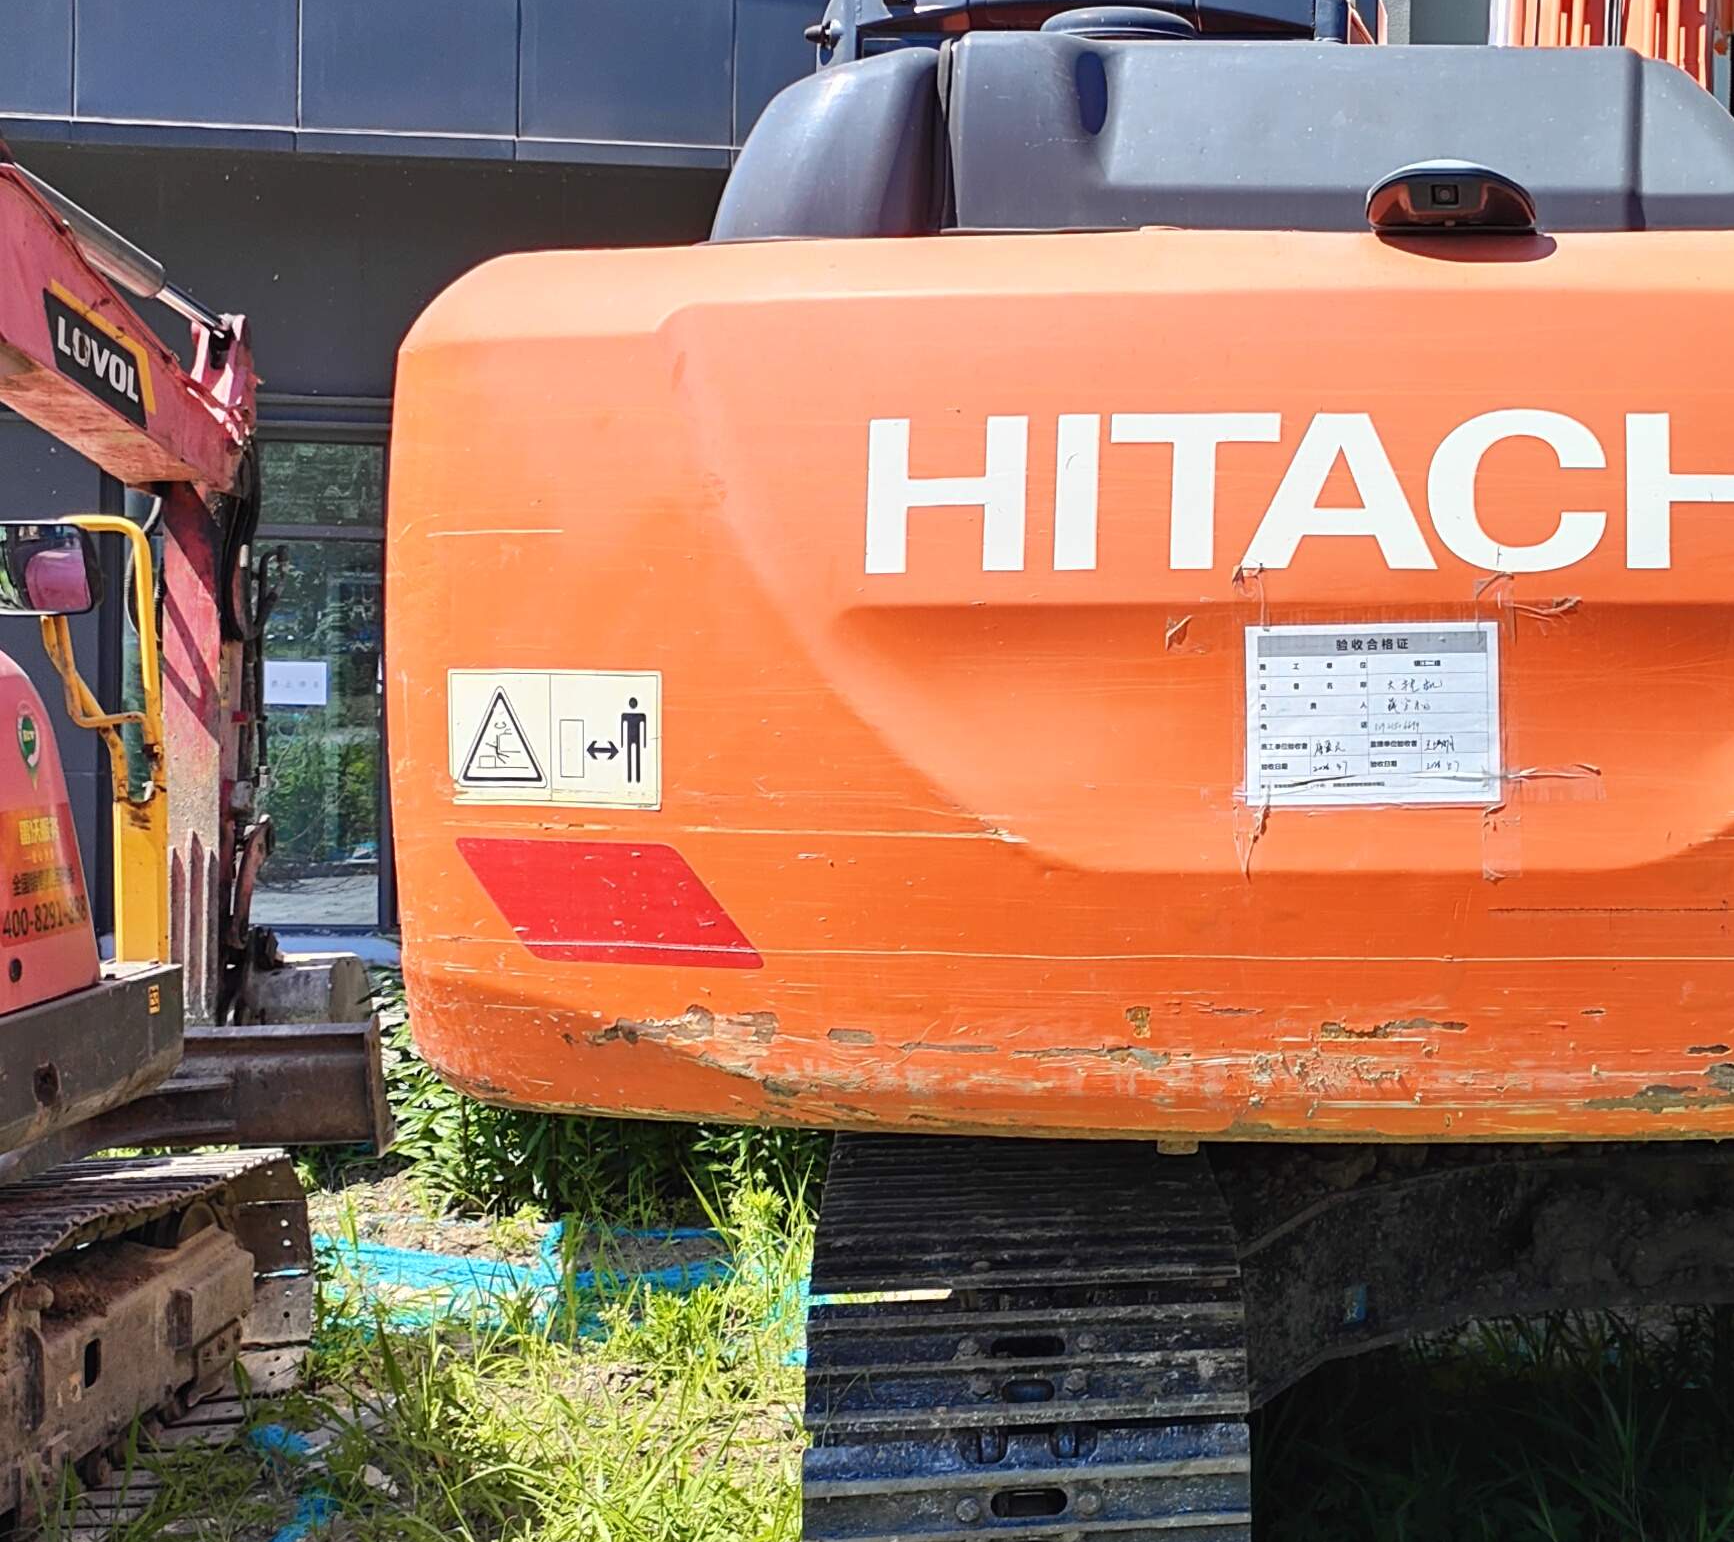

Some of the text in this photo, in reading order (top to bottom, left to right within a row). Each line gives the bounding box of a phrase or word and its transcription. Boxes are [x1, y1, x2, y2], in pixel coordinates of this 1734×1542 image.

[58, 316, 139, 403] LOVOL
[1335, 637, 1409, 651] 验收合格证
